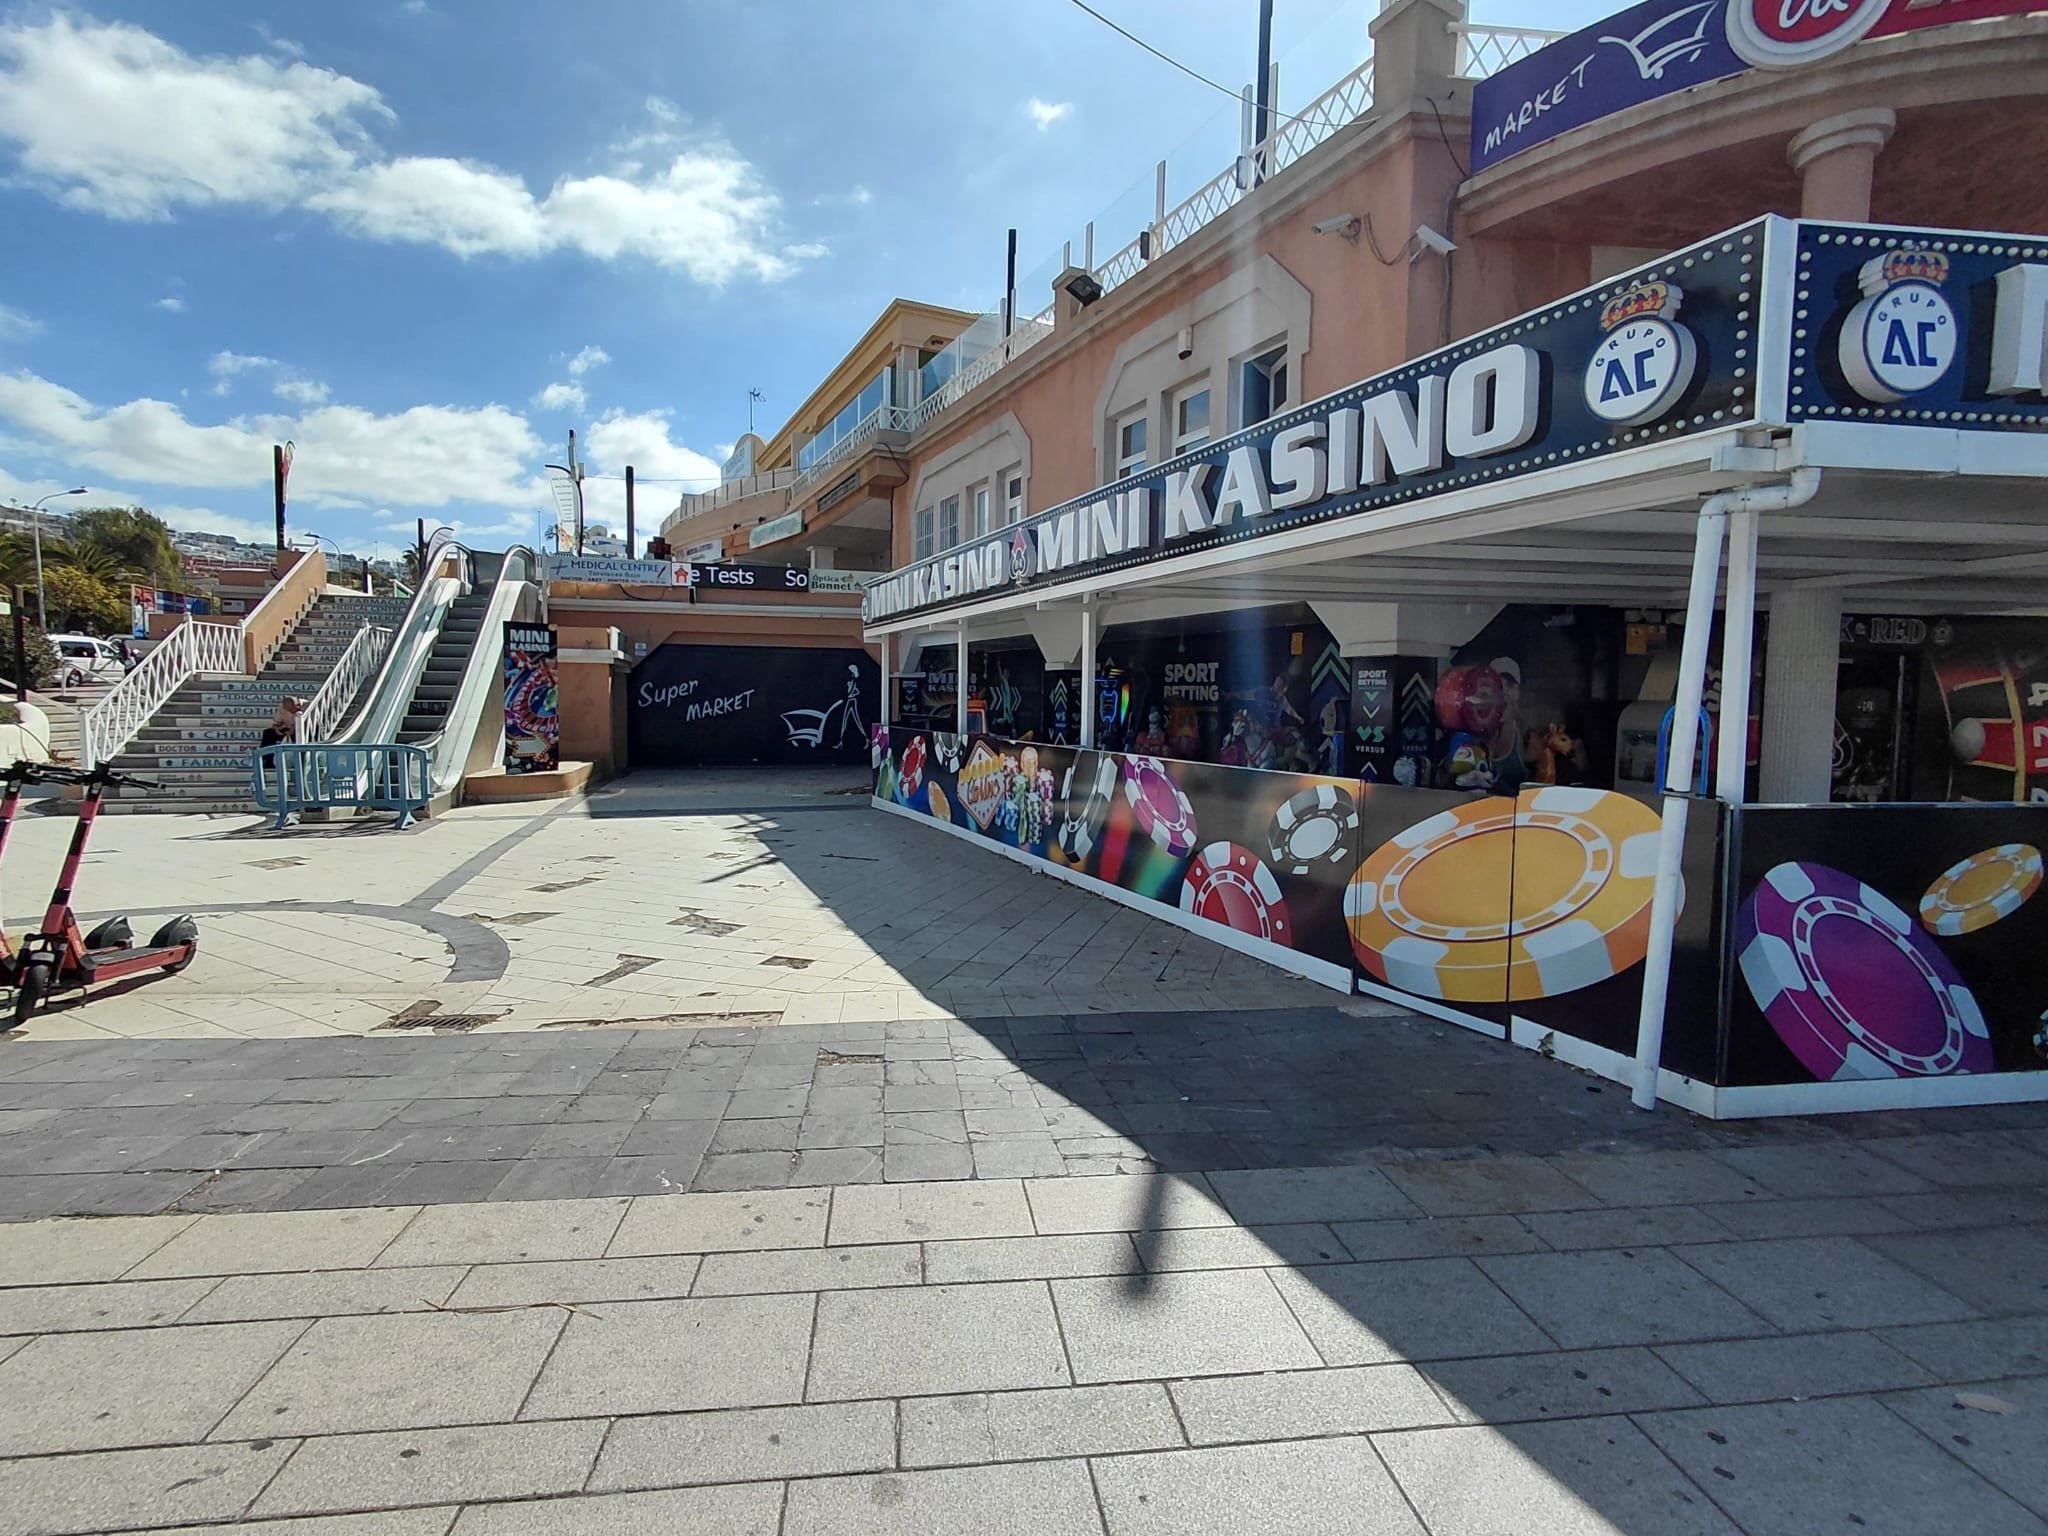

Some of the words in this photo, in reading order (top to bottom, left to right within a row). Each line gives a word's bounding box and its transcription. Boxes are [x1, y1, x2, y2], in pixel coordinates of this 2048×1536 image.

[1483, 52, 1597, 156] MARKET
[1877, 291, 1949, 327] GRUPO
[1594, 327, 1667, 369] GRUPO
[1036, 487, 1151, 574] MINI
[1163, 343, 1541, 540] KASINO
[570, 559, 618, 571] MEDICAL
[620, 562, 660, 574] CENTRE
[705, 566, 755, 585] Tests
[811, 580, 852, 591] Bonnet
[871, 573, 911, 619] MINI
[913, 540, 1006, 608] KASINO
[509, 628, 550, 644] MINI
[509, 642, 550, 653] KASINO
[1164, 662, 1220, 683] SPORT
[1358, 669, 1388, 679] SPORT
[241, 682, 316, 692] FARMACIA
[637, 679, 699, 708] Super
[686, 688, 755, 722] MARKET
[159, 745, 197, 753] DOCTOR
